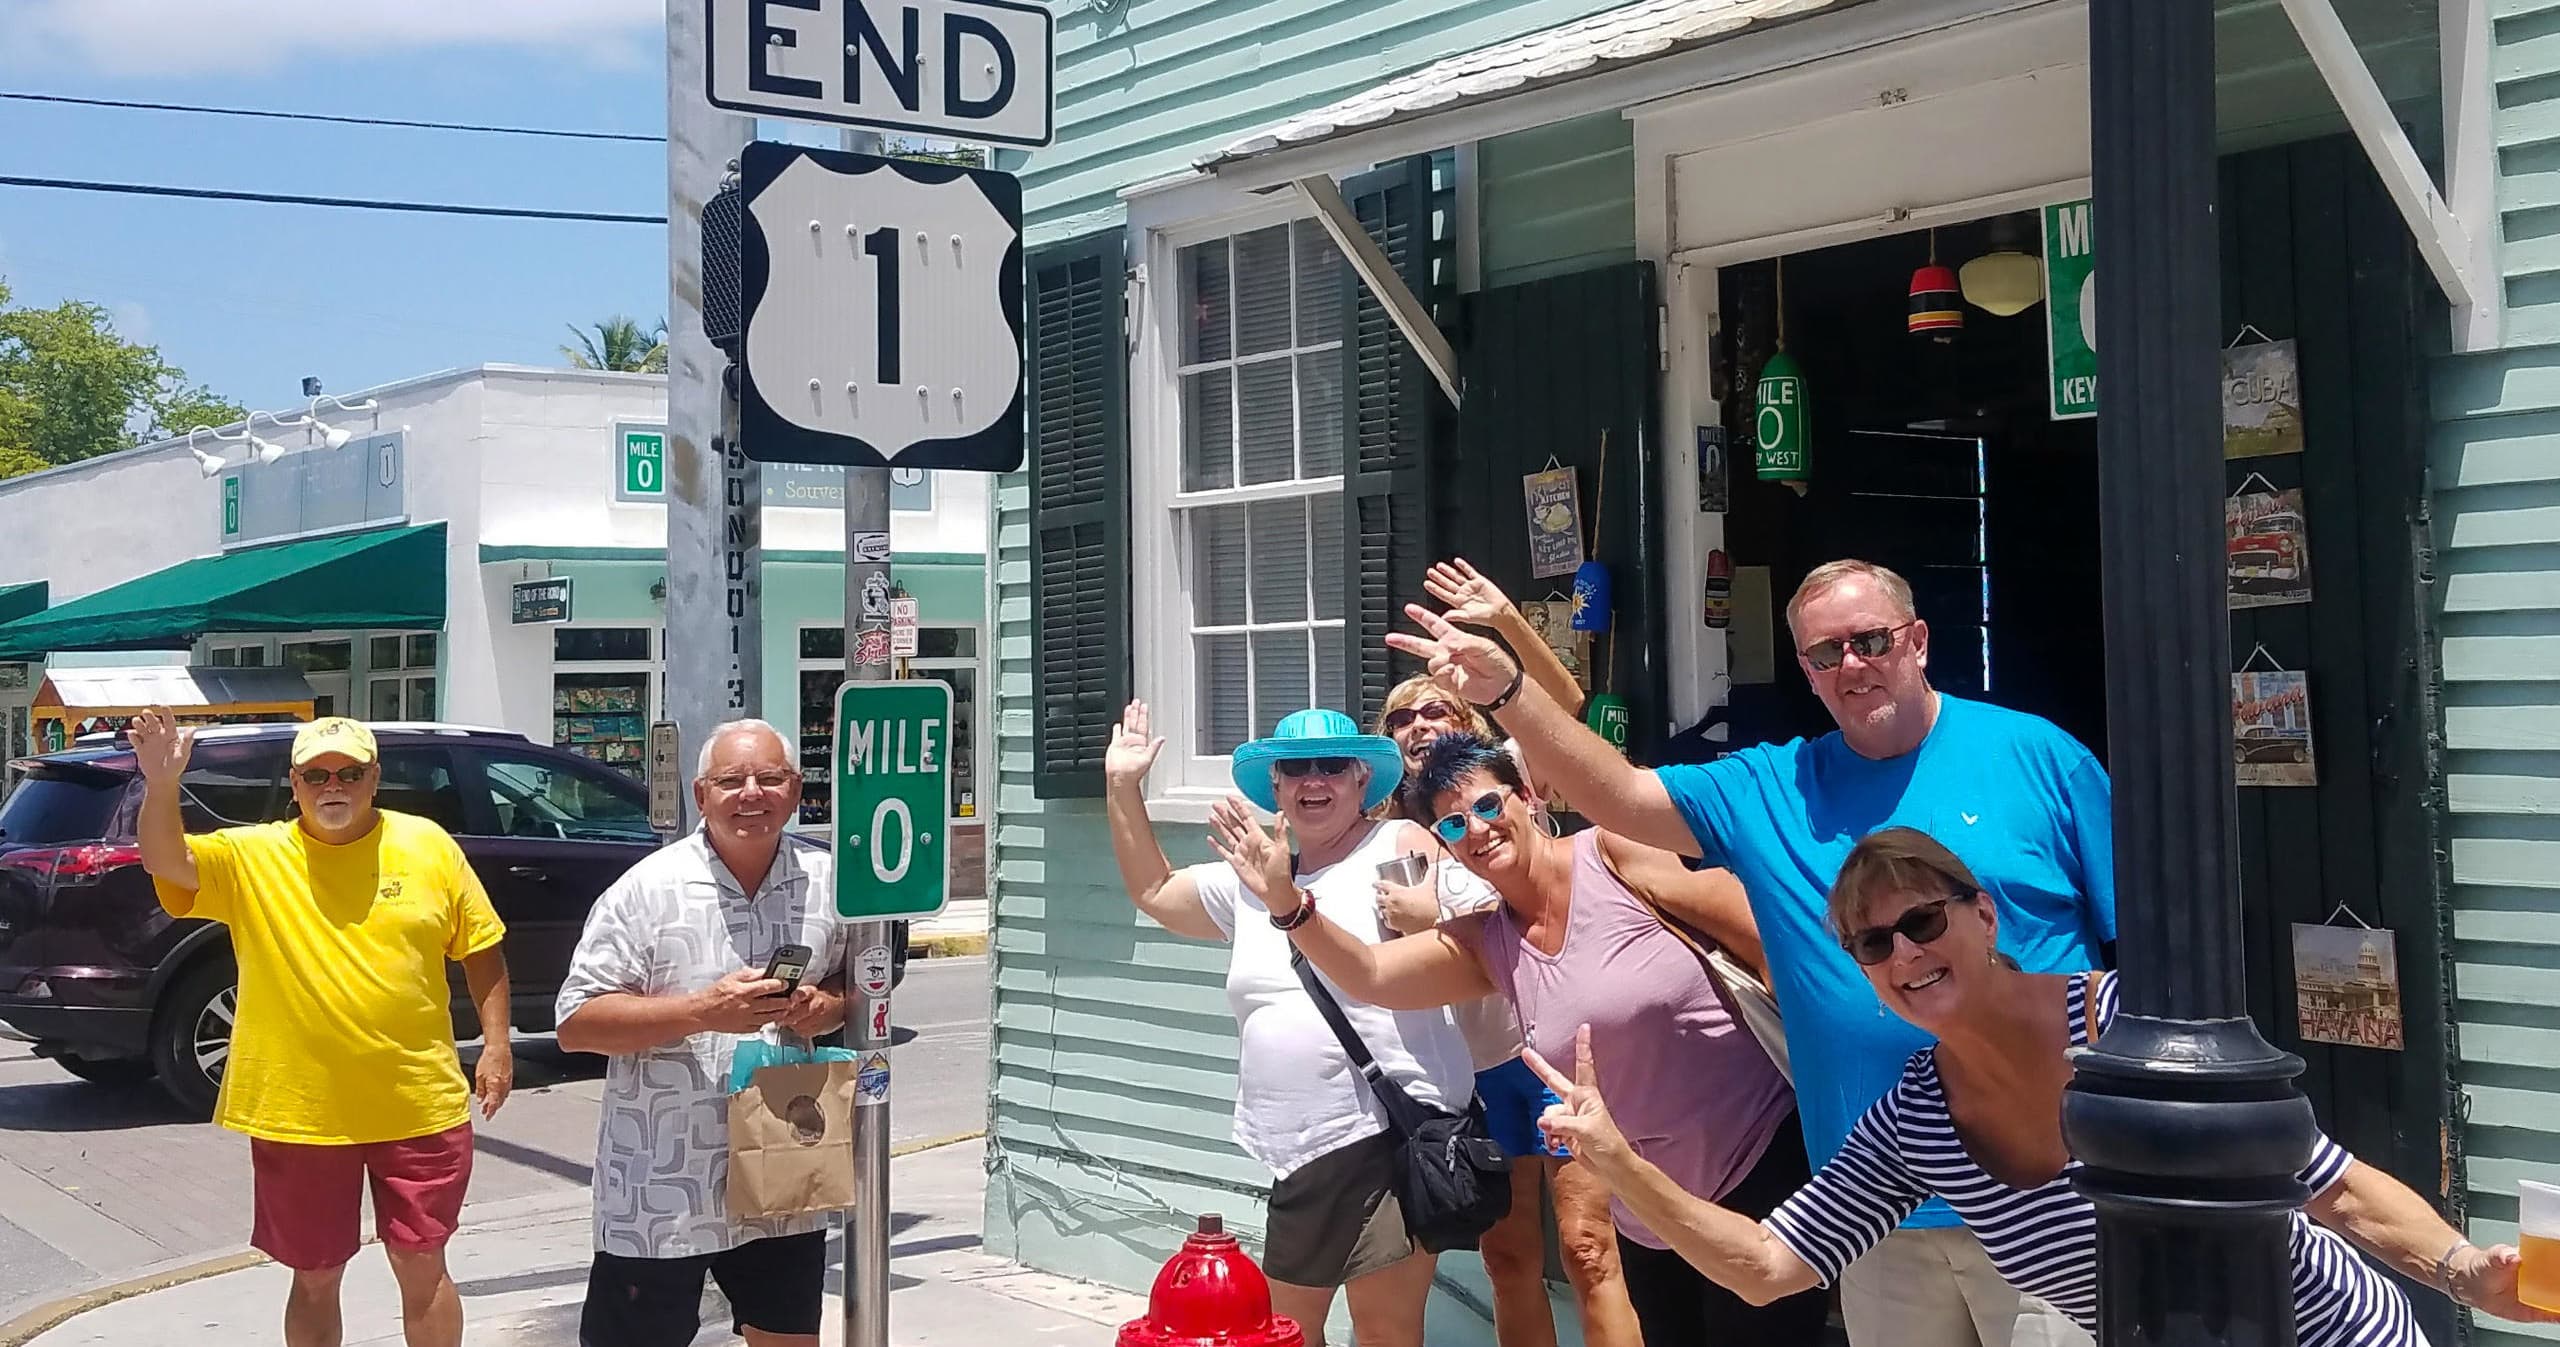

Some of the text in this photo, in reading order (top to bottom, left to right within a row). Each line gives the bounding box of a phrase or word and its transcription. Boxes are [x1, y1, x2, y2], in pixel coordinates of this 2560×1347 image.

[749, 0, 1016, 119] END
[864, 226, 901, 384] 1
[629, 441, 660, 458] MILE
[1766, 451, 1799, 465] WEST
[637, 459, 654, 488] 0
[890, 616, 915, 627] PARKING
[896, 604, 908, 615] NO
[848, 718, 941, 775] MILE
[870, 797, 914, 884] 0
[2298, 1009, 2402, 1047] HAVANA
